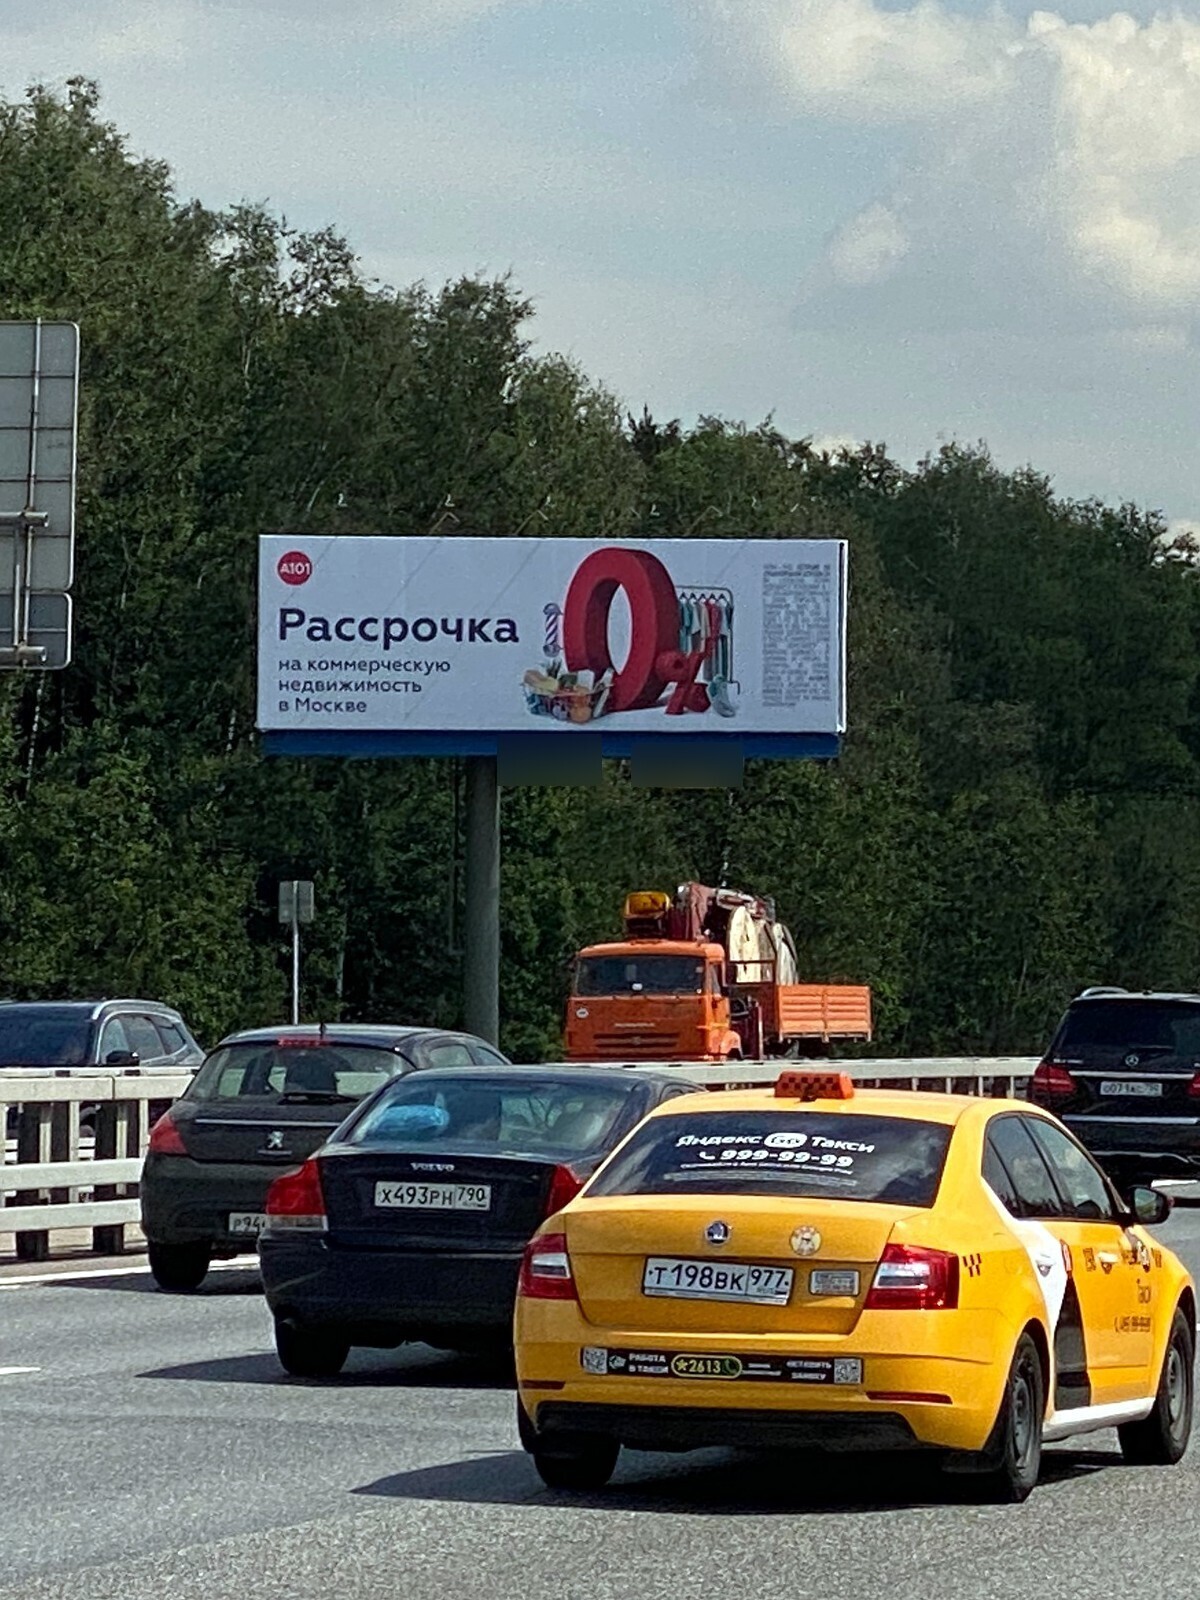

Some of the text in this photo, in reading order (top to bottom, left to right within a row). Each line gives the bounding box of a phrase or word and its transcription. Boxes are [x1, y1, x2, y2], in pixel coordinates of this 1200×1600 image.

[278, 607, 520, 651] Рассрочка
[278, 659, 451, 675] на коммерческую
[278, 679, 423, 694] недвижимость
[278, 697, 367, 713] в Москве
[676, 1135, 763, 1148] Яндекс
[811, 1136, 875, 1154] Такси
[720, 1149, 854, 1168] 999-99-99
[410, 1162, 455, 1172] VOLVO
